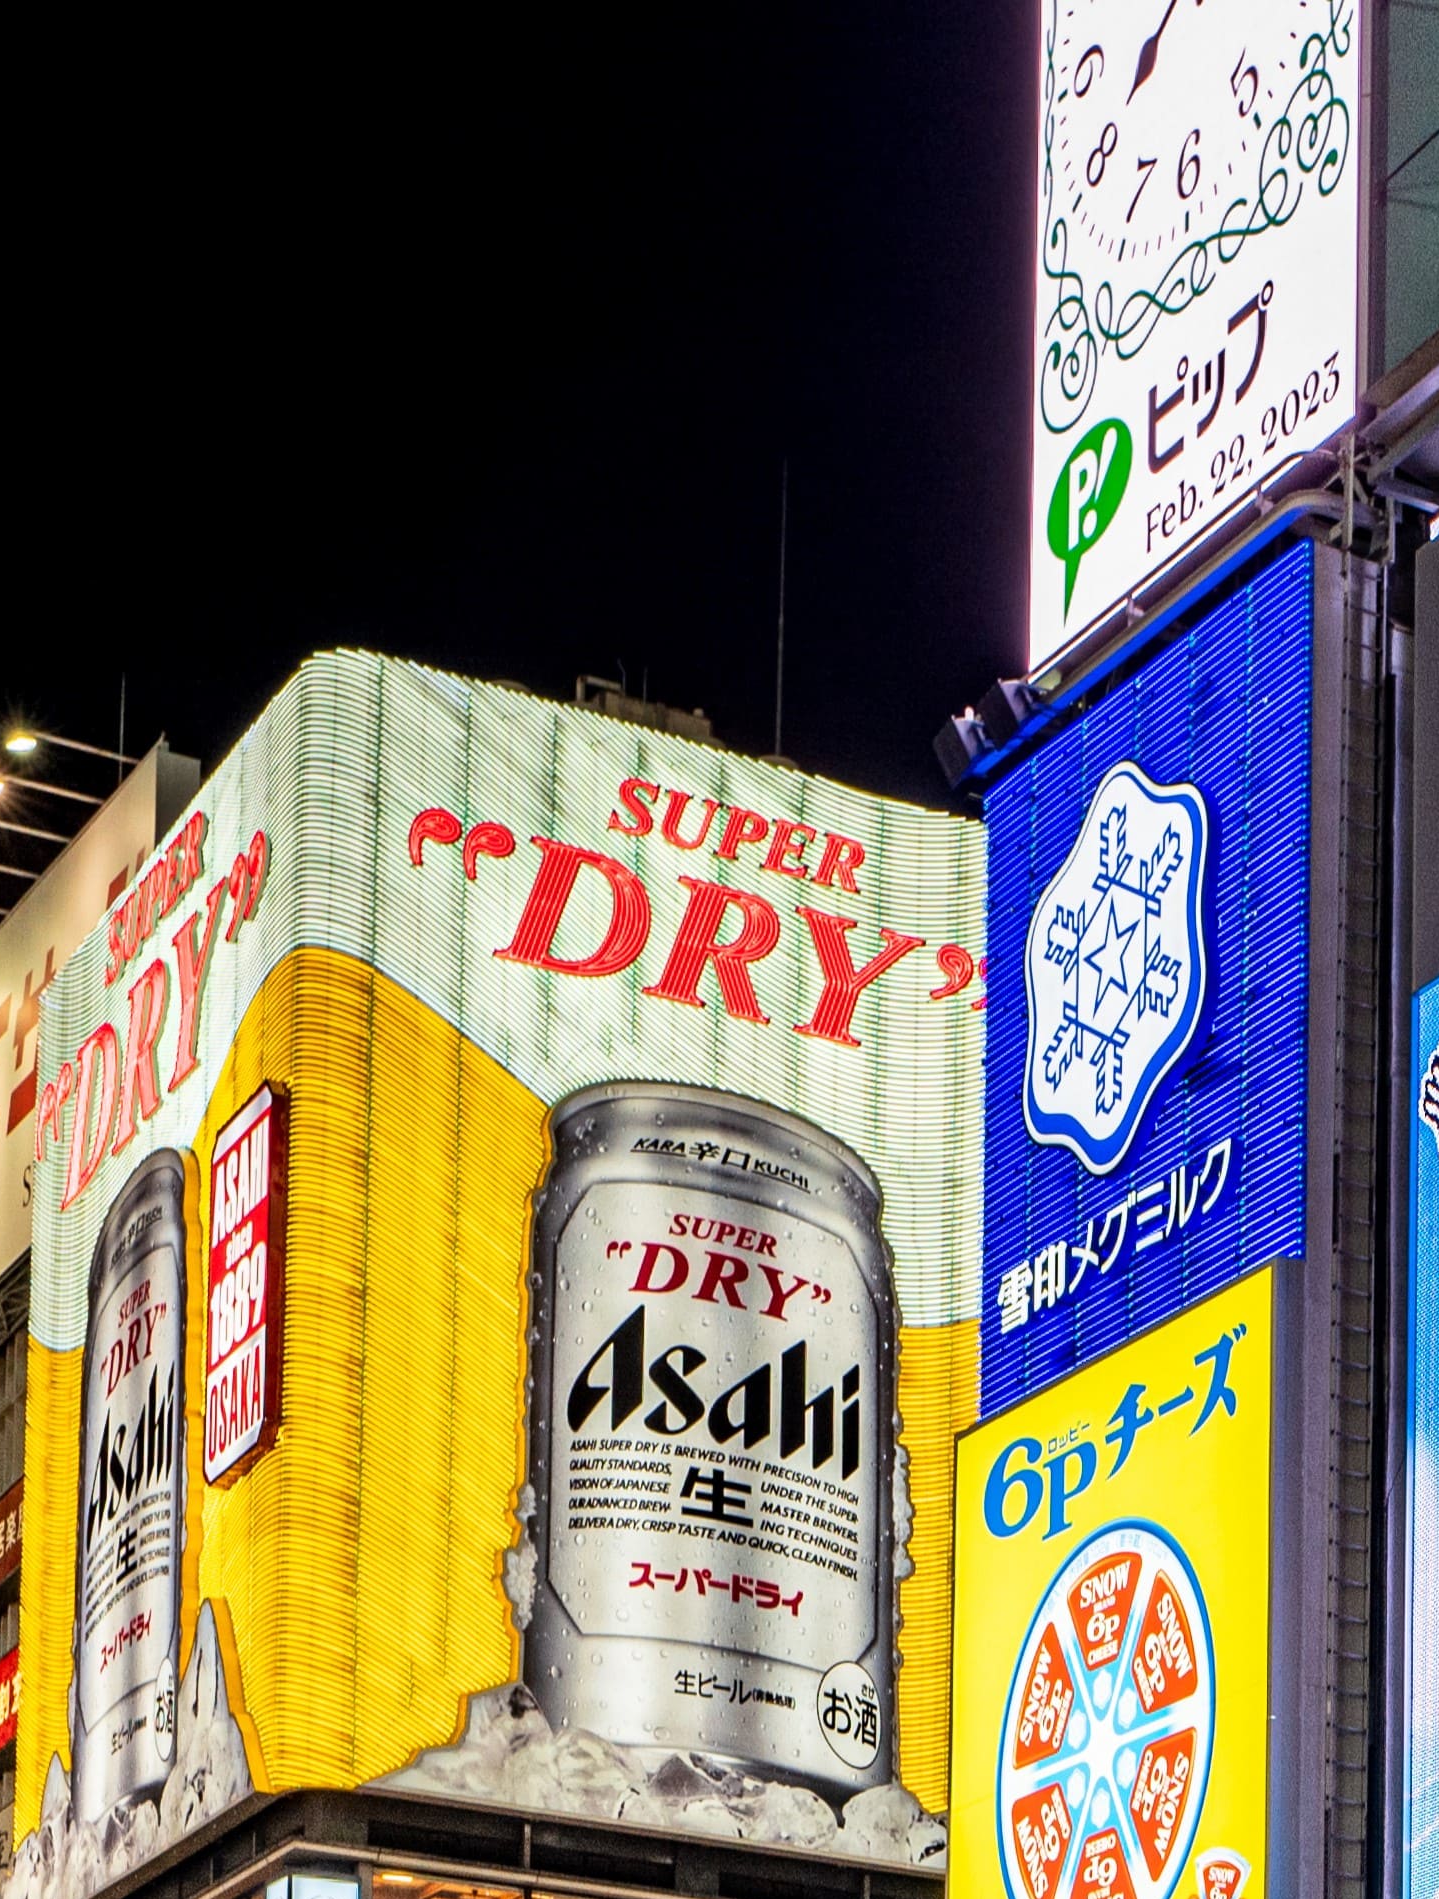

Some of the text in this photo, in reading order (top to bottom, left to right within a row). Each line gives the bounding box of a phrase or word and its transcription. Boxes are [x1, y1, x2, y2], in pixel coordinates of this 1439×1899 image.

[1230, 48, 1258, 116] 5
[1086, 123, 1118, 187] 8
[1176, 129, 1202, 200] 6
[1127, 158, 1157, 223] 7
[1146, 280, 1274, 475] ピップ
[1144, 351, 1341, 554] Feb. 22, 2023
[608, 776, 866, 893] SUPER
[104, 809, 205, 989] SUPER
[211, 1114, 270, 1249] ASAHI
[632, 1137, 811, 1190] KARA 辛口 KUCHI
[224, 1220, 253, 1269] since
[668, 1213, 777, 1259] SUPER
[995, 1137, 1232, 1335] 雪印メグミルク
[117, 1279, 152, 1329] SUPER
[210, 1241, 267, 1367] 1889
[207, 1343, 262, 1463] OSAKA
[567, 1304, 861, 1481] Asahi
[85, 1359, 175, 1554] Asahi
[570, 1440, 597, 1452] ASAHI
[599, 1439, 632, 1452] SUPER
[635, 1441, 660, 1454] DRY
[661, 1443, 671, 1455] IS
[674, 1446, 726, 1465] BREWED
[728, 1454, 762, 1473] WITH
[764, 1463, 822, 1489] PRECISION
[823, 1481, 837, 1496] TO
[613, 1478, 672, 1494] JAPANESE
[761, 1501, 811, 1525] MASTER
[680, 1466, 754, 1530] 生
[761, 1481, 803, 1504] UNDER
[805, 1492, 826, 1511] THE
[115, 1525, 139, 1586] 生
[641, 1520, 677, 1534] CRISP
[677, 1523, 716, 1541] TASTE
[716, 1529, 747, 1547] AND
[791, 1547, 827, 1571] CLEAN
[786, 1527, 859, 1562] TECHNIQUES
[628, 1561, 805, 1617] スーパードライ
[1079, 1561, 1131, 1609] SNOW
[822, 1687, 878, 1750] お酒
